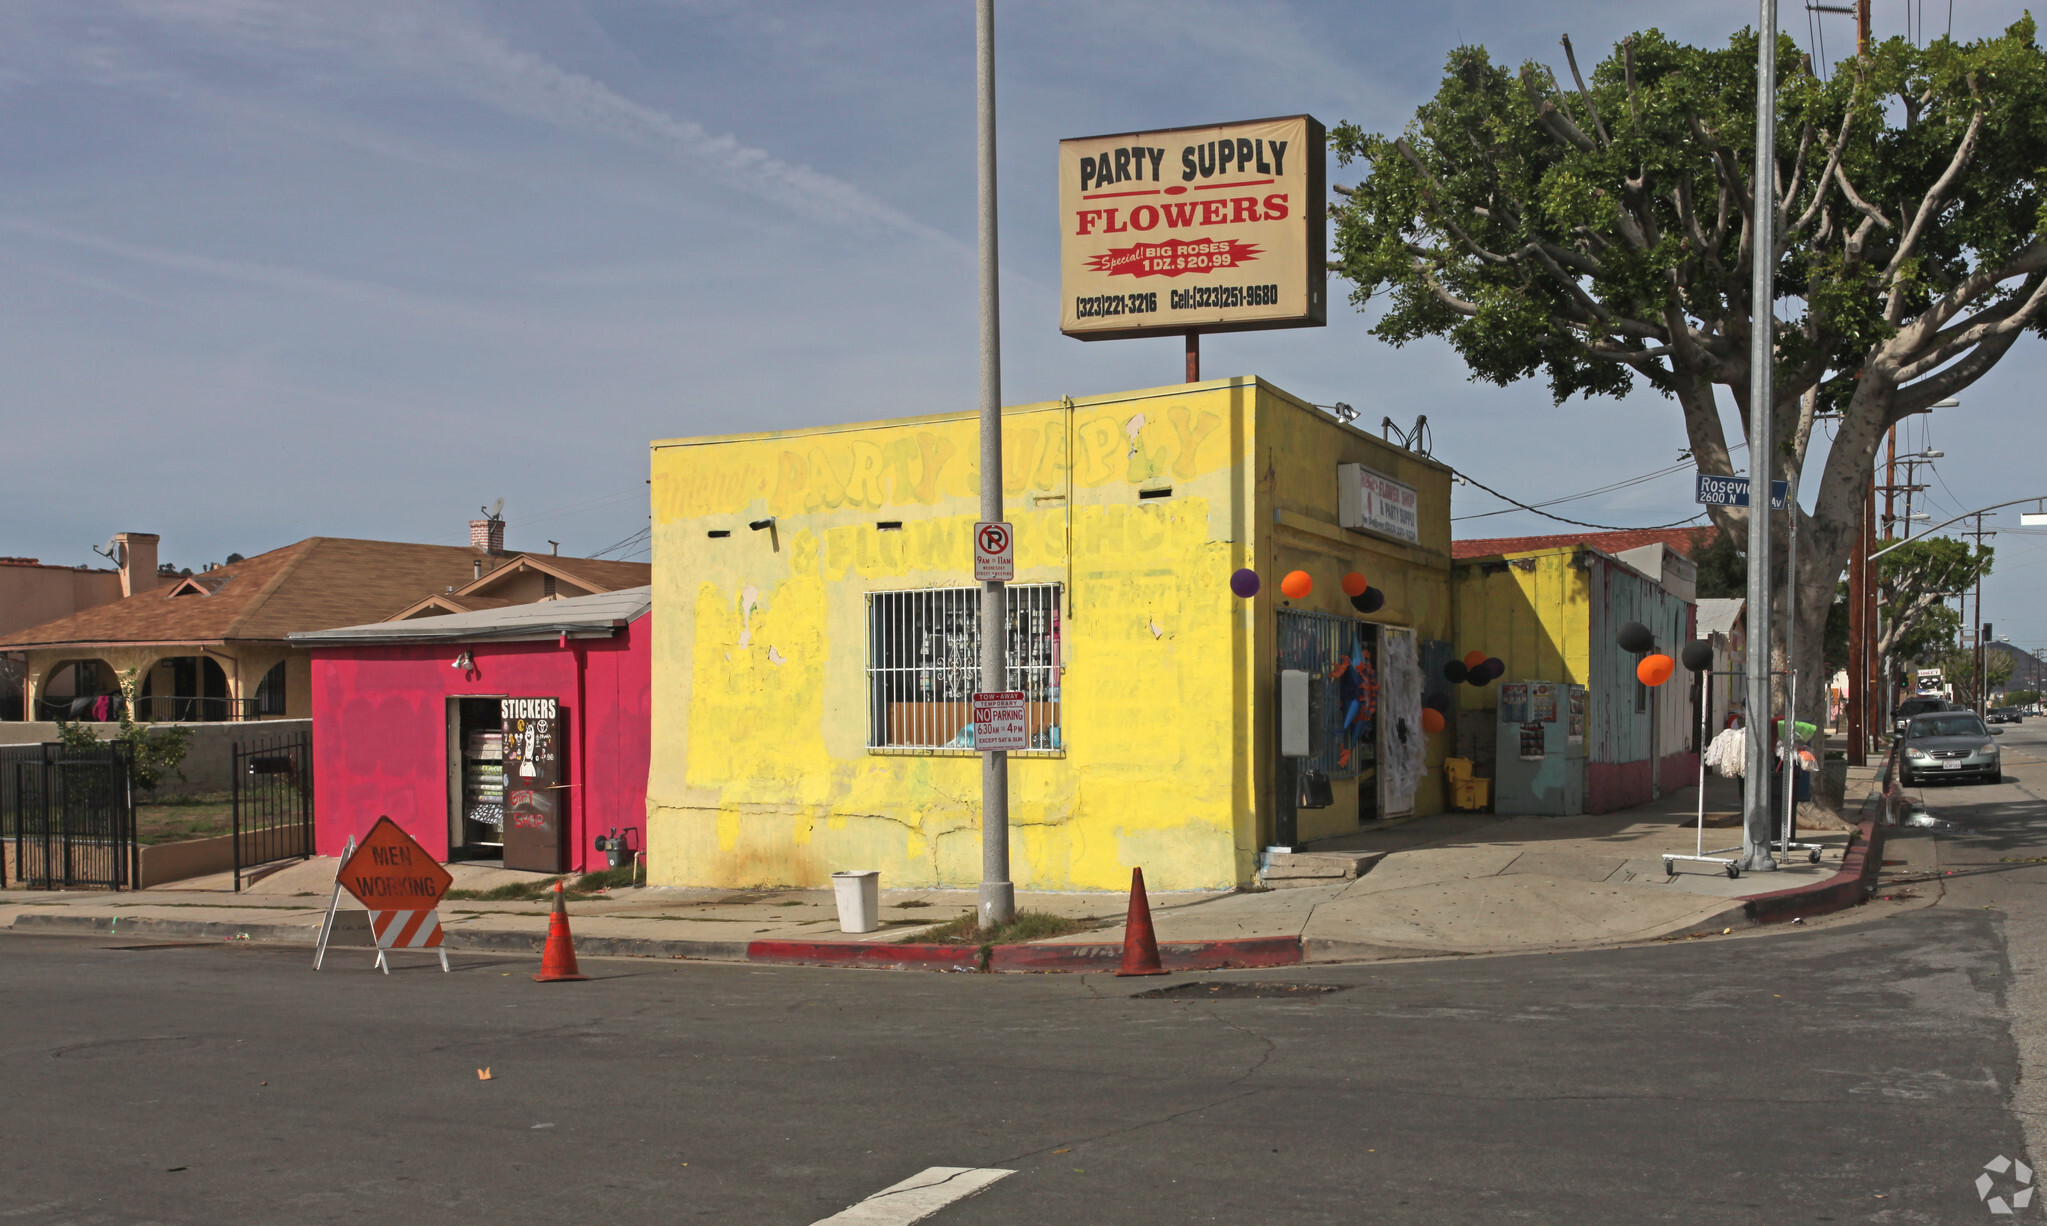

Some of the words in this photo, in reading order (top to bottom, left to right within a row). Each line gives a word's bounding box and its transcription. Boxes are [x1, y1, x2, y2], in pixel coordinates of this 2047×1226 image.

[1080, 146, 1165, 192] PARTY
[1181, 138, 1288, 182] SUPPLY
[1075, 193, 1289, 236] FLOWERS
[1101, 247, 1144, 271] Special!
[1145, 246, 1172, 258] BIG
[1177, 242, 1230, 255] ROSES
[1142, 261, 1150, 271] 1
[1153, 258, 1175, 270] DZ.
[1076, 292, 1158, 320] (323)221-3216
[770, 432, 955, 513] PARTY
[1701, 477, 1749, 495] Rosevi
[1700, 492, 1725, 503] 2600
[1729, 494, 1736, 504] N
[977, 556, 990, 564] 9AM
[998, 556, 1011, 564] 11AM
[501, 698, 556, 719] STICKERS
[976, 709, 991, 722] NO
[992, 710, 1023, 721] PARKING
[510, 790, 536, 806] GIFT
[514, 812, 545, 830] SHOP
[372, 846, 413, 866] MEN
[356, 876, 437, 897] WORKING
